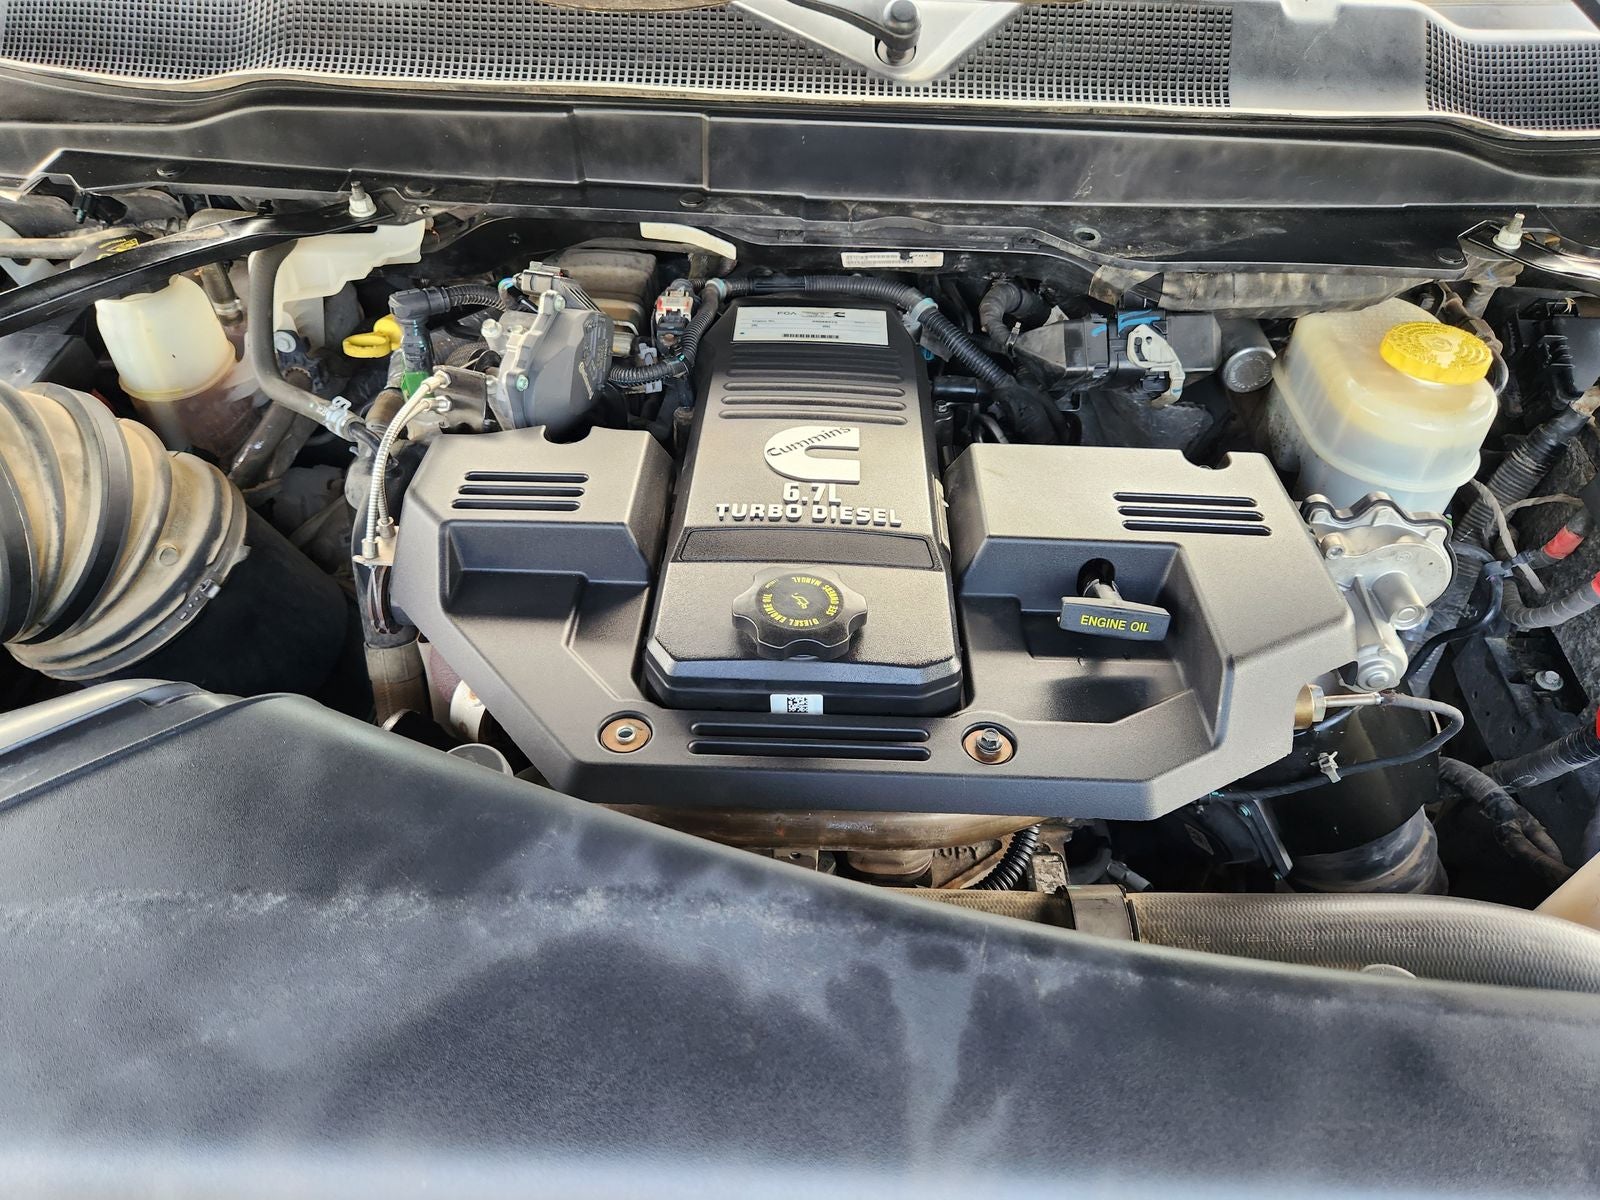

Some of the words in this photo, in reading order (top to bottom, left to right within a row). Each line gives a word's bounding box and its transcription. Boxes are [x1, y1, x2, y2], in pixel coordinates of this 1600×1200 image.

[766, 427, 851, 457] Cummins
[783, 482, 842, 506] 6.7L
[716, 503, 803, 521] TURBO
[811, 505, 902, 527] DIESEL
[791, 576, 822, 587] MANUAL
[762, 593, 773, 603] OIL
[763, 603, 787, 623] ENGINE
[826, 605, 839, 616] SEE
[789, 618, 820, 627] DIESEL
[1080, 614, 1127, 631] ENGINE
[1130, 621, 1150, 633] OIL
